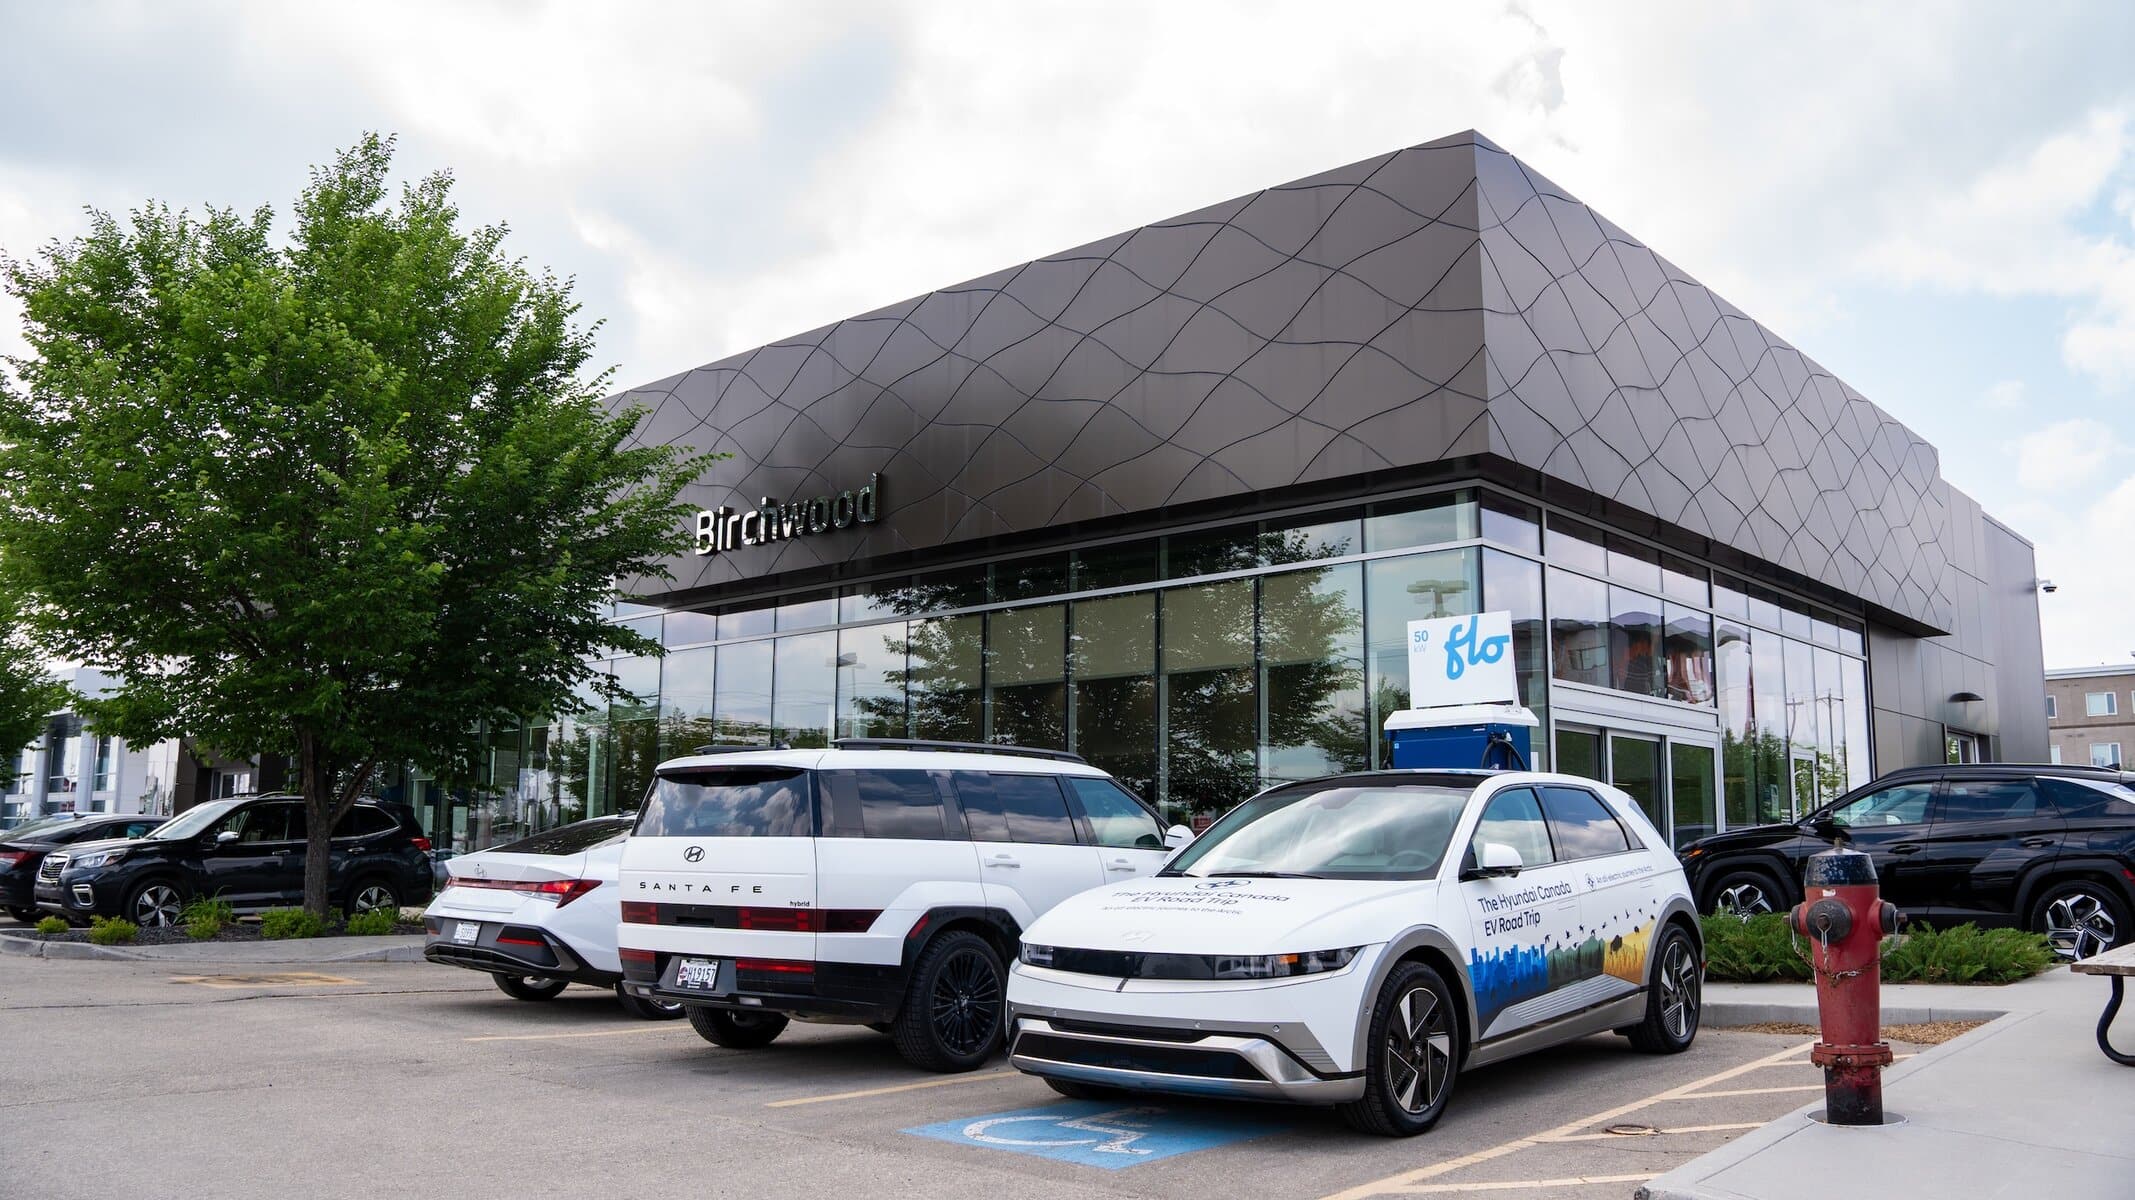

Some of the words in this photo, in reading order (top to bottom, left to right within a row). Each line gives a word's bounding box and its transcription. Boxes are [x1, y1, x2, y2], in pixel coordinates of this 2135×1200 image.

[695, 472, 879, 555] Birchwood
[1414, 630, 1429, 642] 50
[1444, 615, 1510, 680] flo
[639, 881, 712, 894] SANTA
[731, 885, 762, 894] FE
[1206, 896, 1239, 905] Trip
[1217, 892, 1290, 902] Canada
[1477, 896, 1498, 913] The
[1497, 886, 1538, 910] Hyundai
[1537, 881, 1572, 900] Canada
[789, 900, 810, 908] hybrid
[1484, 918, 1498, 936] EV
[1499, 912, 1523, 933] Road
[1523, 909, 1541, 927] Trip
